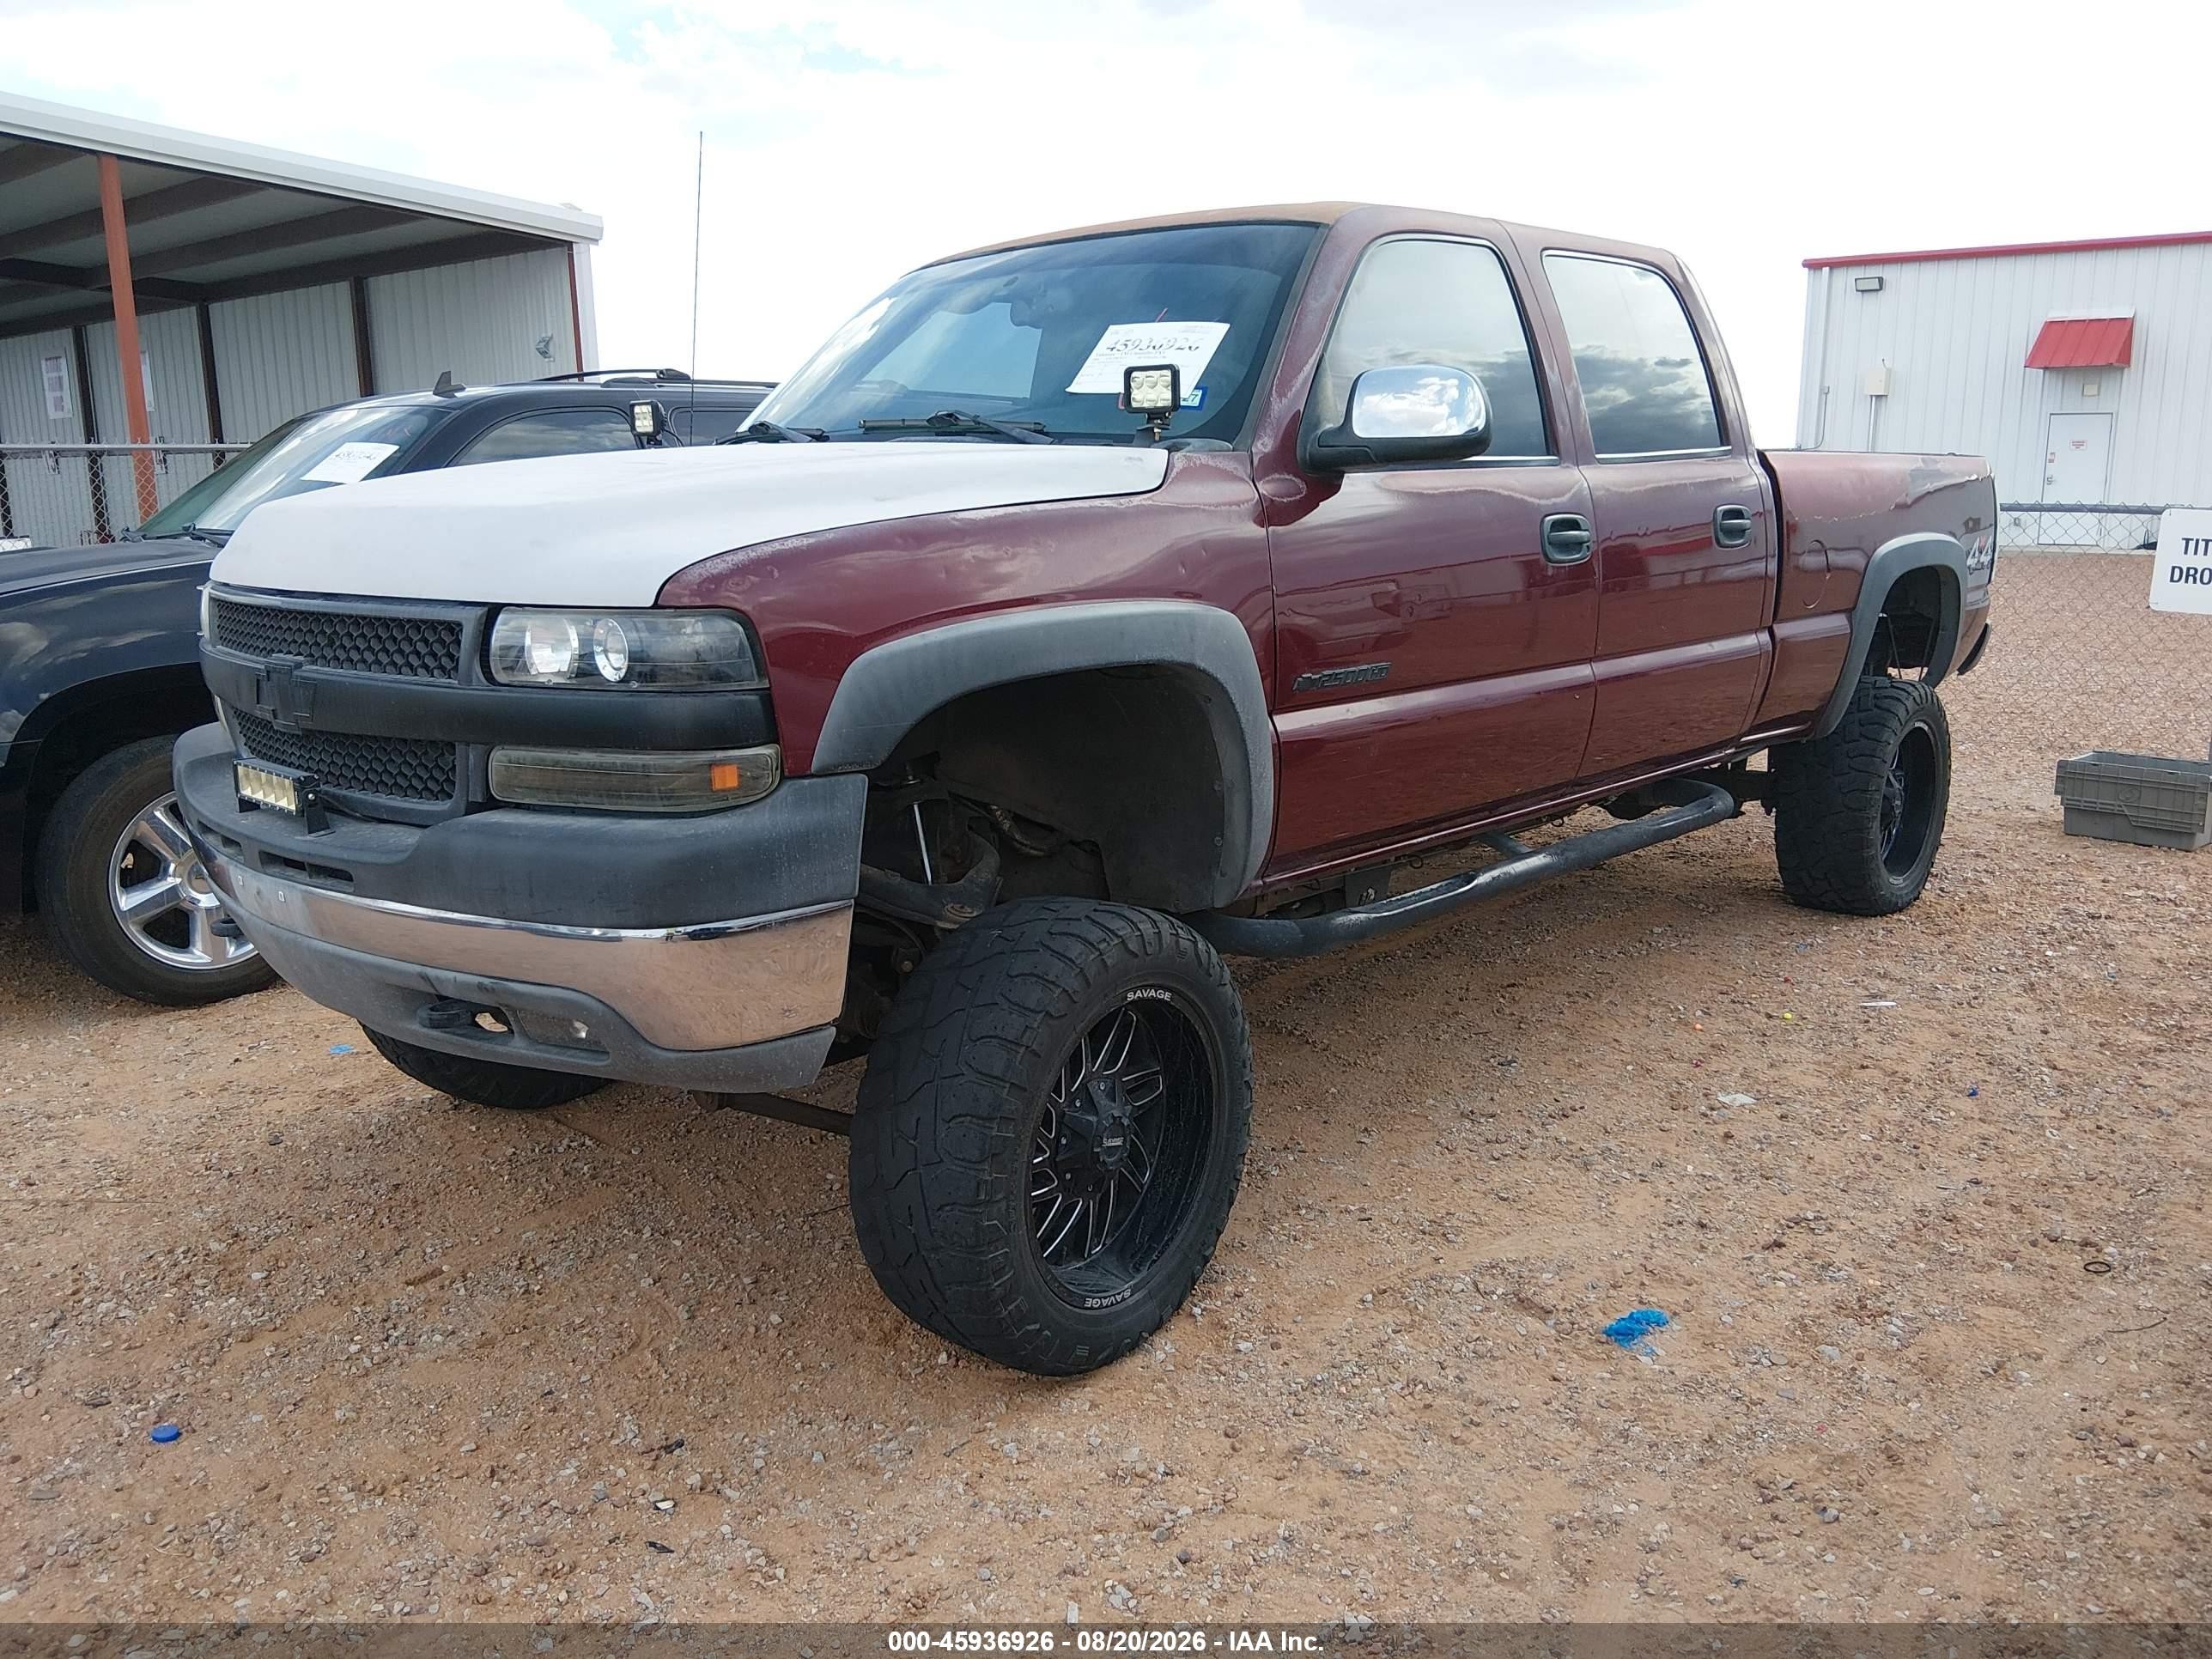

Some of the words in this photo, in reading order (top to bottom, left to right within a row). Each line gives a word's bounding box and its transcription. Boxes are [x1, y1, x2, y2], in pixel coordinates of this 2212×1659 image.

[1106, 337, 1203, 352] 45936926
[2181, 538, 2212, 556] TIT
[2169, 565, 2212, 586] DRO
[1127, 988, 1172, 1002] SAVAGE
[1085, 1288, 1132, 1308] SAVAGE
